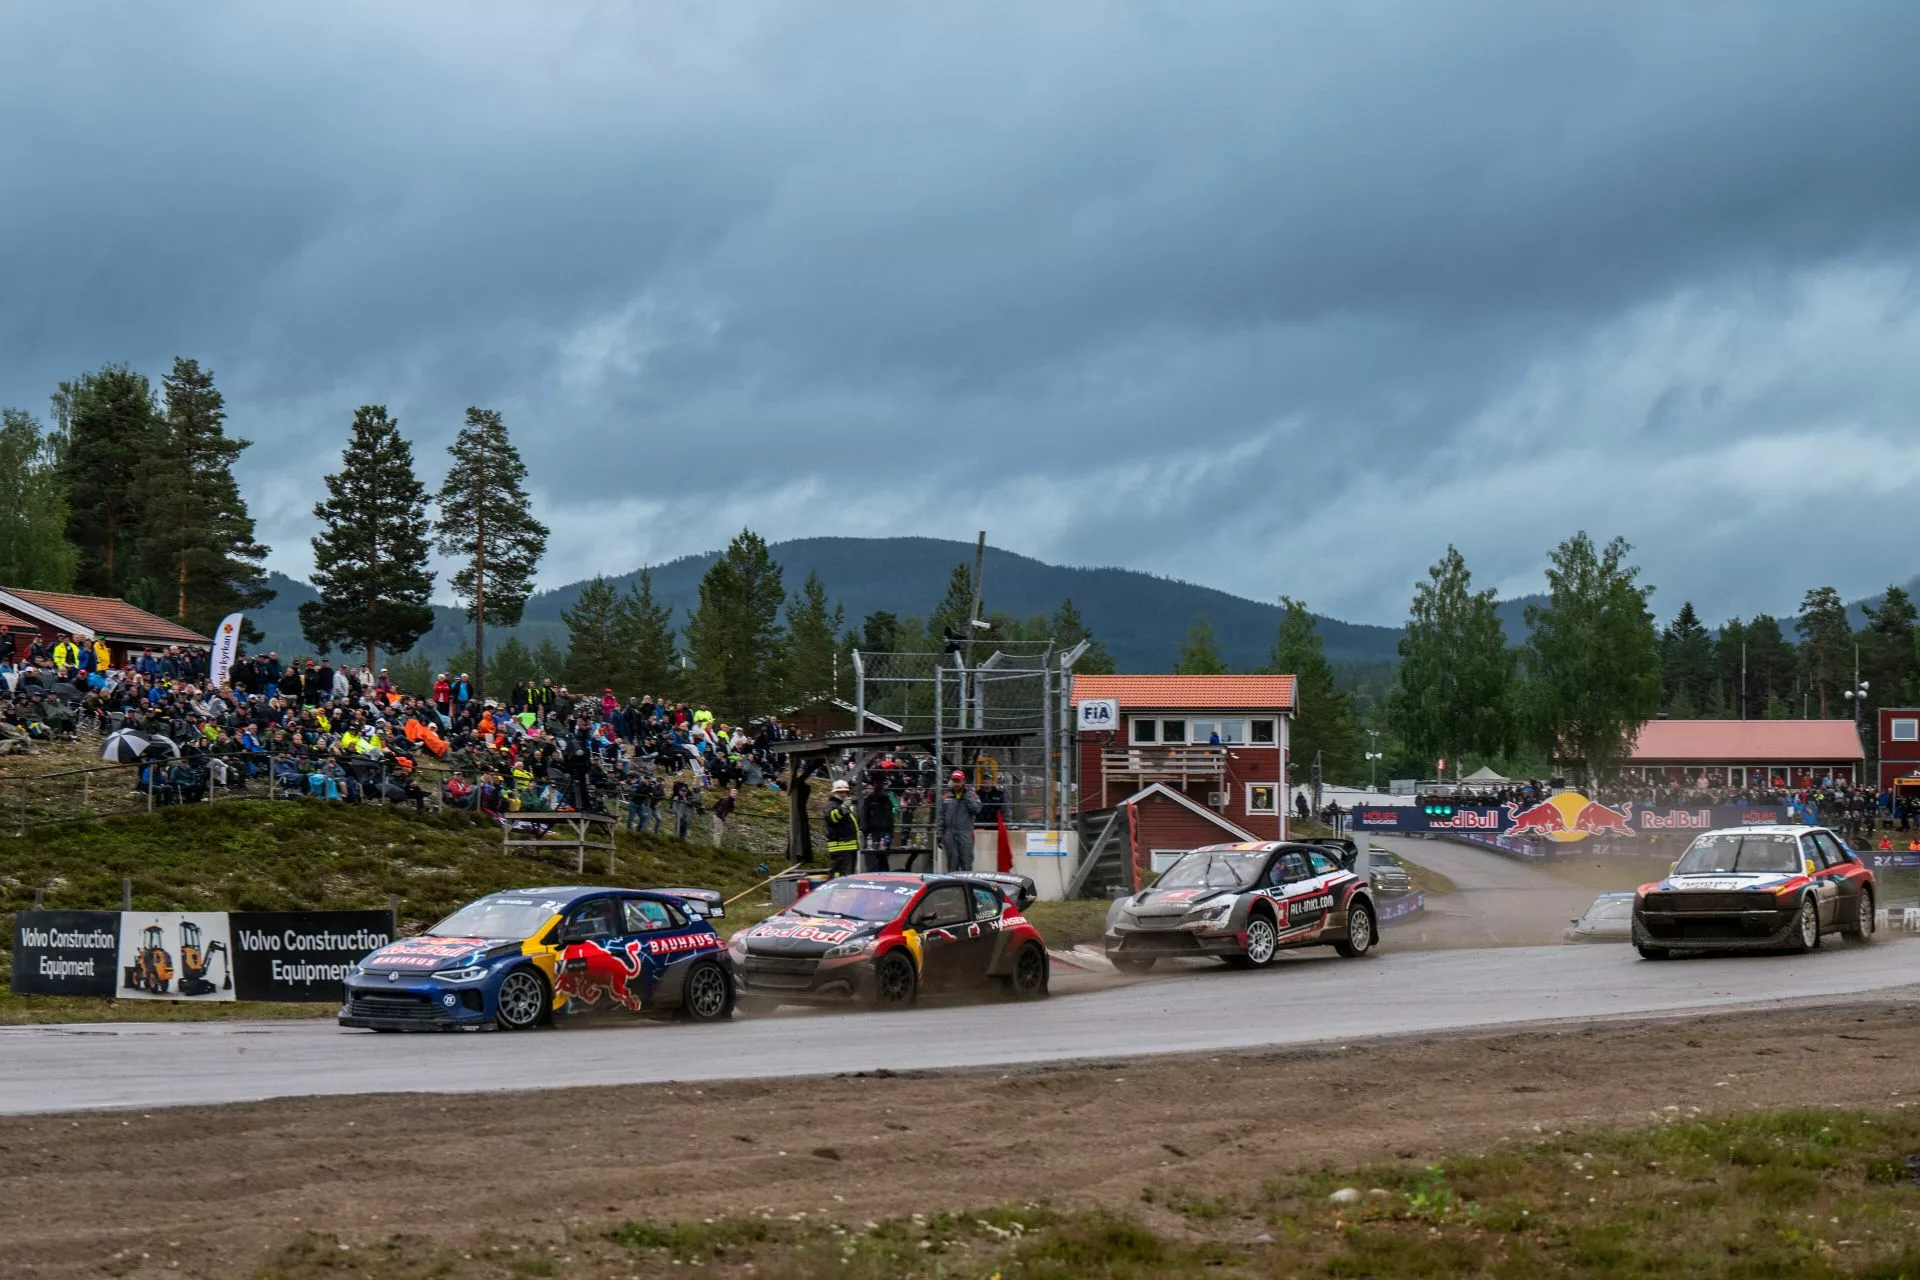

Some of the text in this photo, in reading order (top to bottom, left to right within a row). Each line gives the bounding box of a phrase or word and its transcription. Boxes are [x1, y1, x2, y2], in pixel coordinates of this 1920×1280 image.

[1465, 811, 1498, 828] Bull
[1642, 810, 1711, 828] Red Bull
[1874, 856, 1891, 866] RX
[975, 911, 997, 920] HANSEN
[989, 917, 1027, 930] HANSEN
[22, 928, 114, 949] Volvo Construction
[239, 929, 389, 951] Volvo Construction
[750, 924, 852, 944] Red Bull
[650, 934, 714, 953] BAUHAUS
[40, 955, 95, 980] Equipment
[372, 956, 439, 967] BAUHAUS
